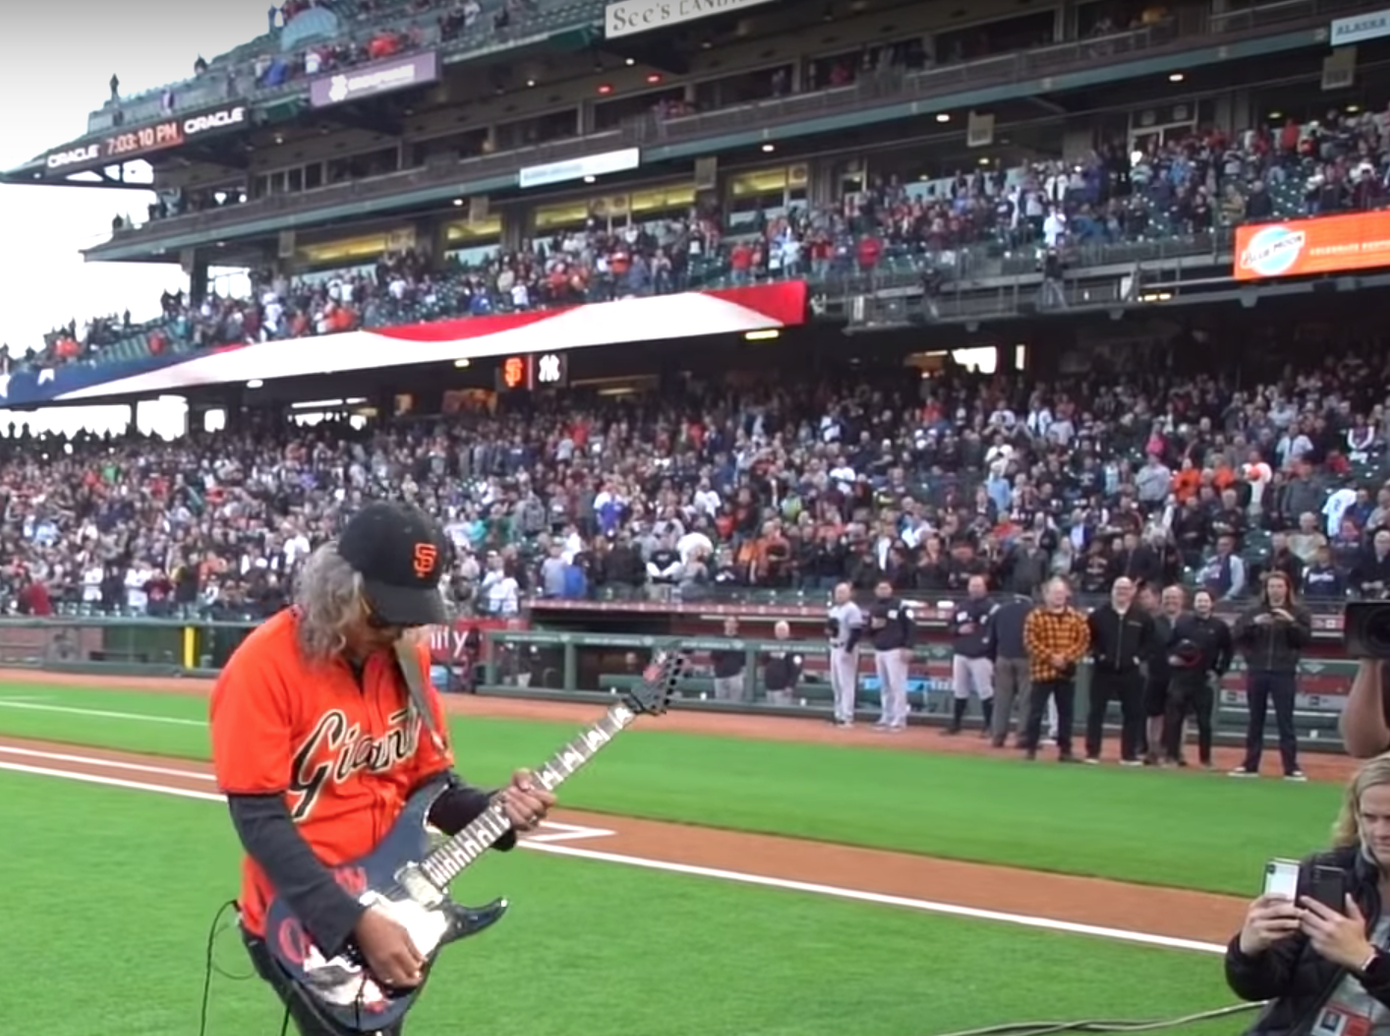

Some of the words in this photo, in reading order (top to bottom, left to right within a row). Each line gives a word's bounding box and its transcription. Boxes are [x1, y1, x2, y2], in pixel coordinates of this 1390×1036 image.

[613, 3, 671, 31] See's
[47, 144, 101, 168] ORACLE
[183, 106, 245, 134] ORACLE
[413, 543, 438, 578] SF
